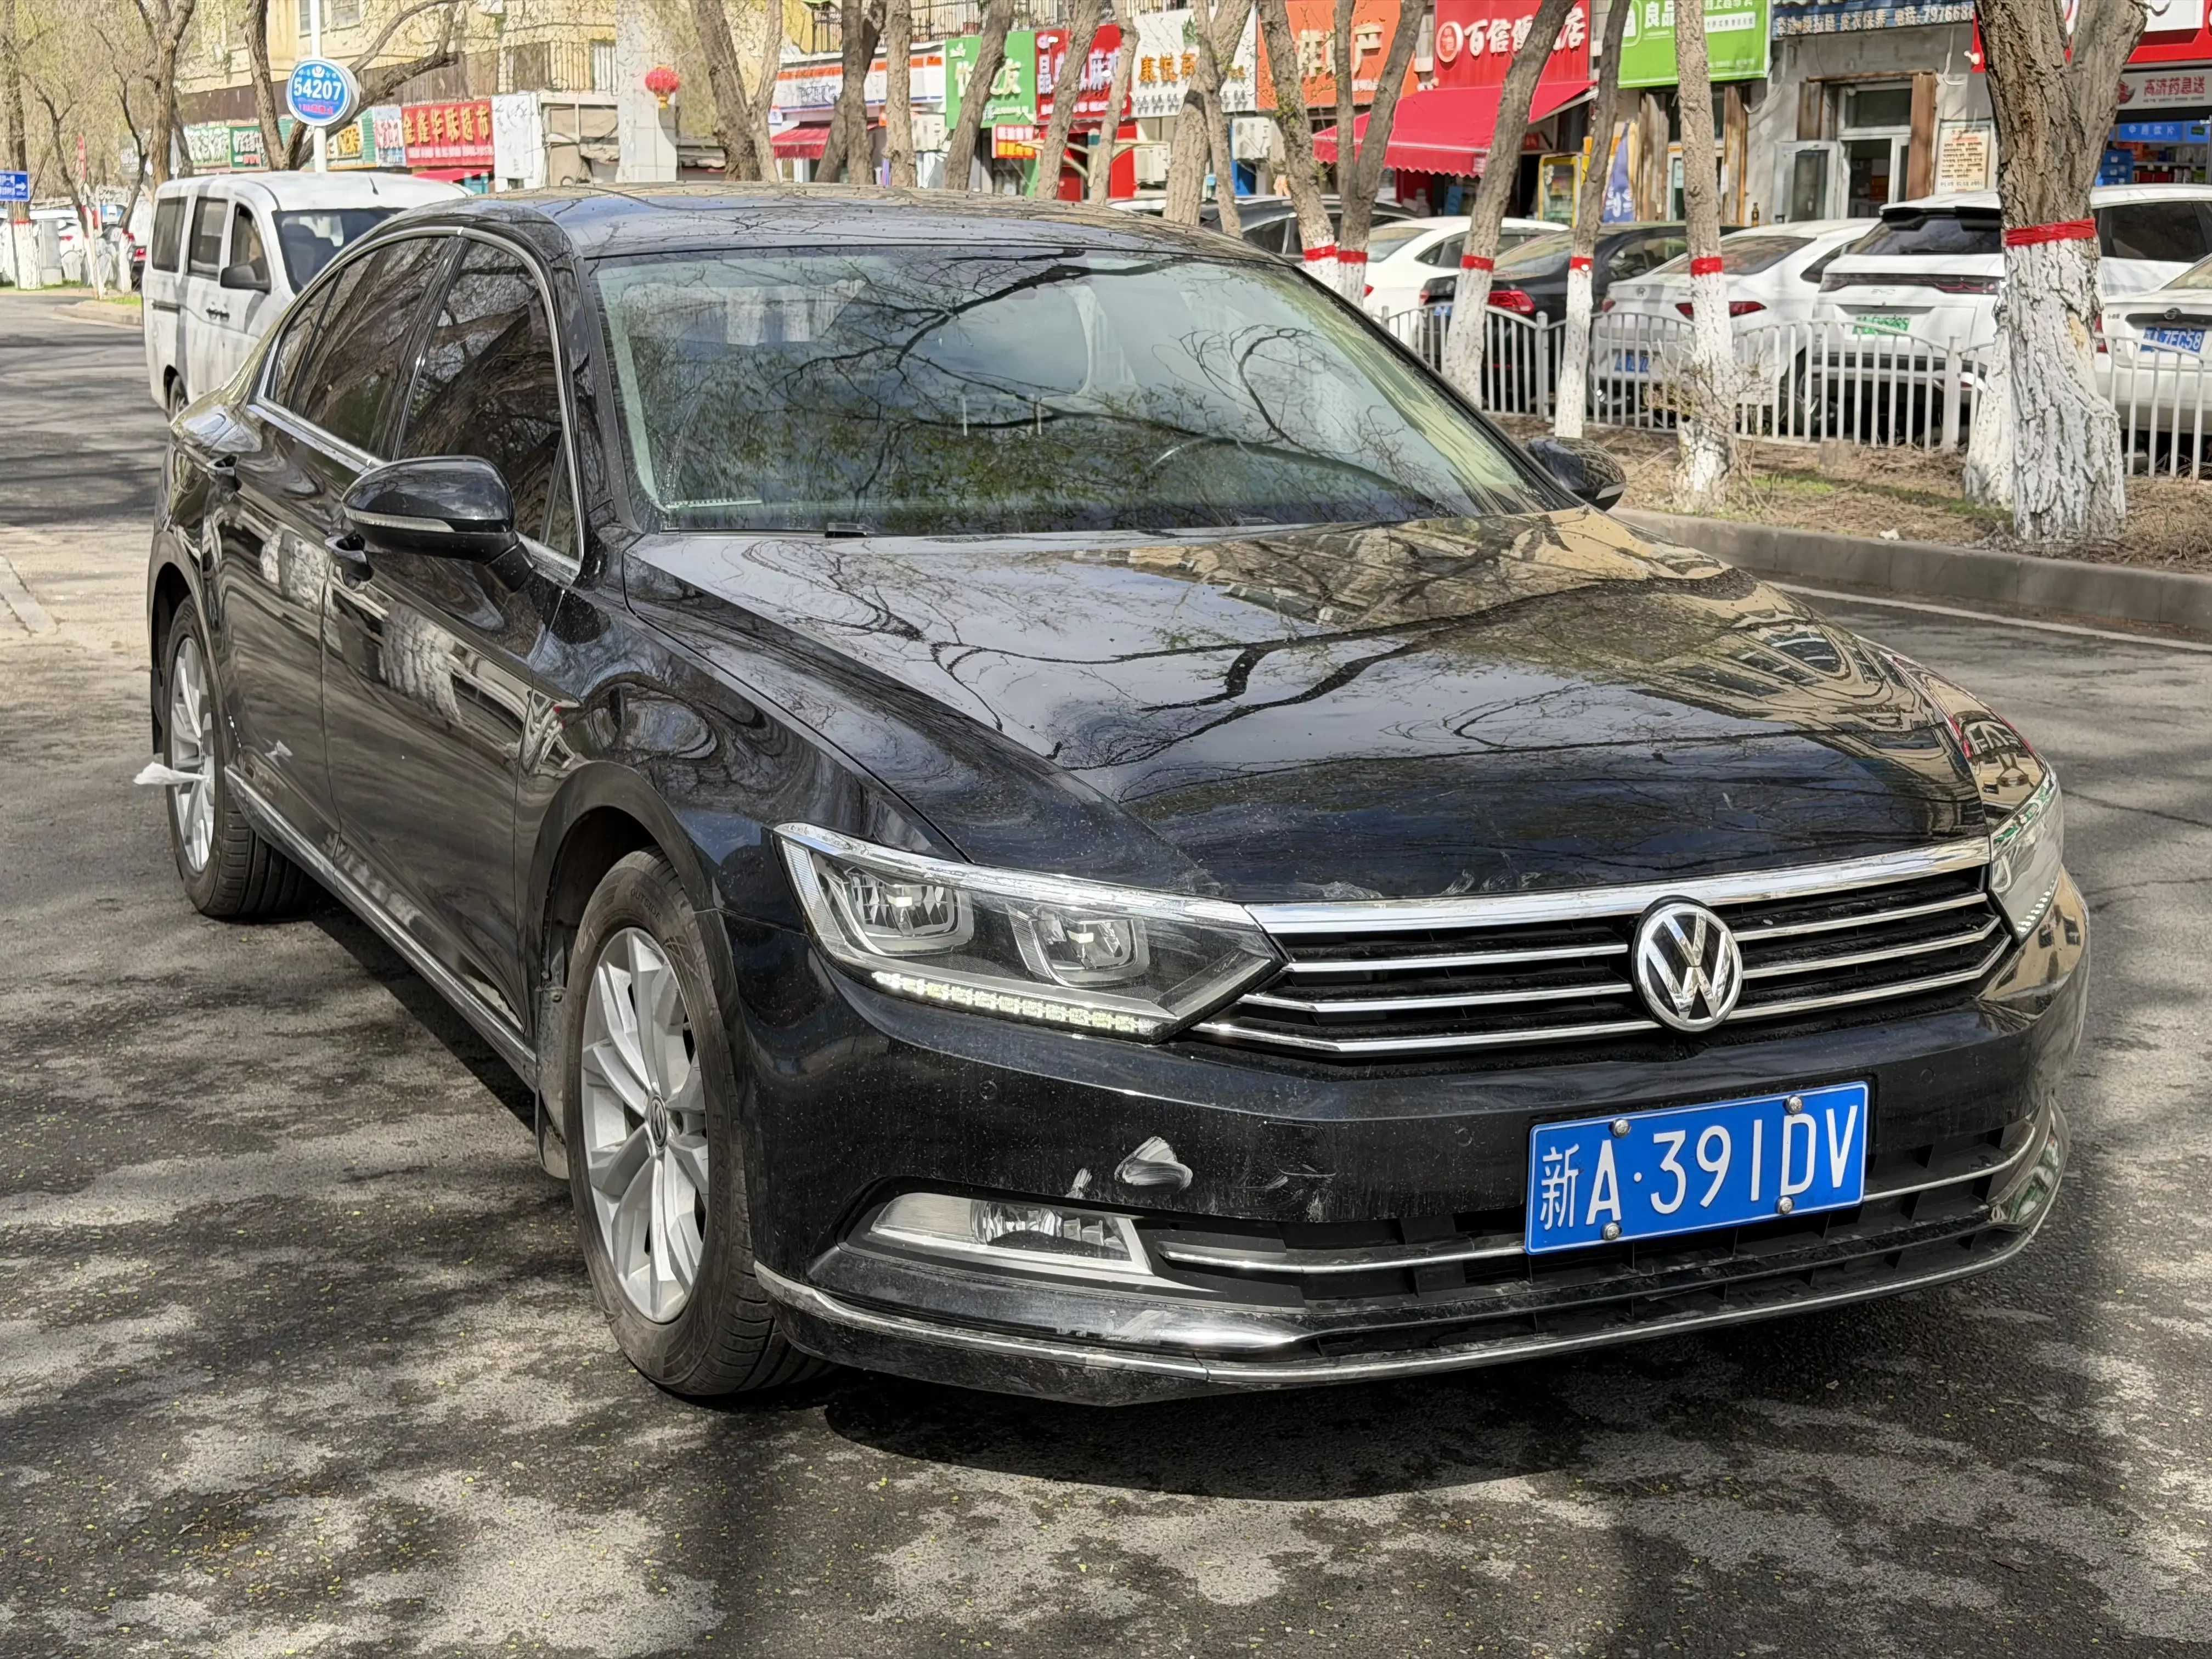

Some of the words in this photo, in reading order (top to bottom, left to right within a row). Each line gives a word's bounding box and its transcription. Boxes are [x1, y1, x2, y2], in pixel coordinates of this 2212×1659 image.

[294, 77, 342, 101] 54207
[2144, 76, 2205, 97] 高济药急送
[630, 888, 662, 922] OUTSIDE
[1539, 1104, 1859, 1231] 新A·391DV
